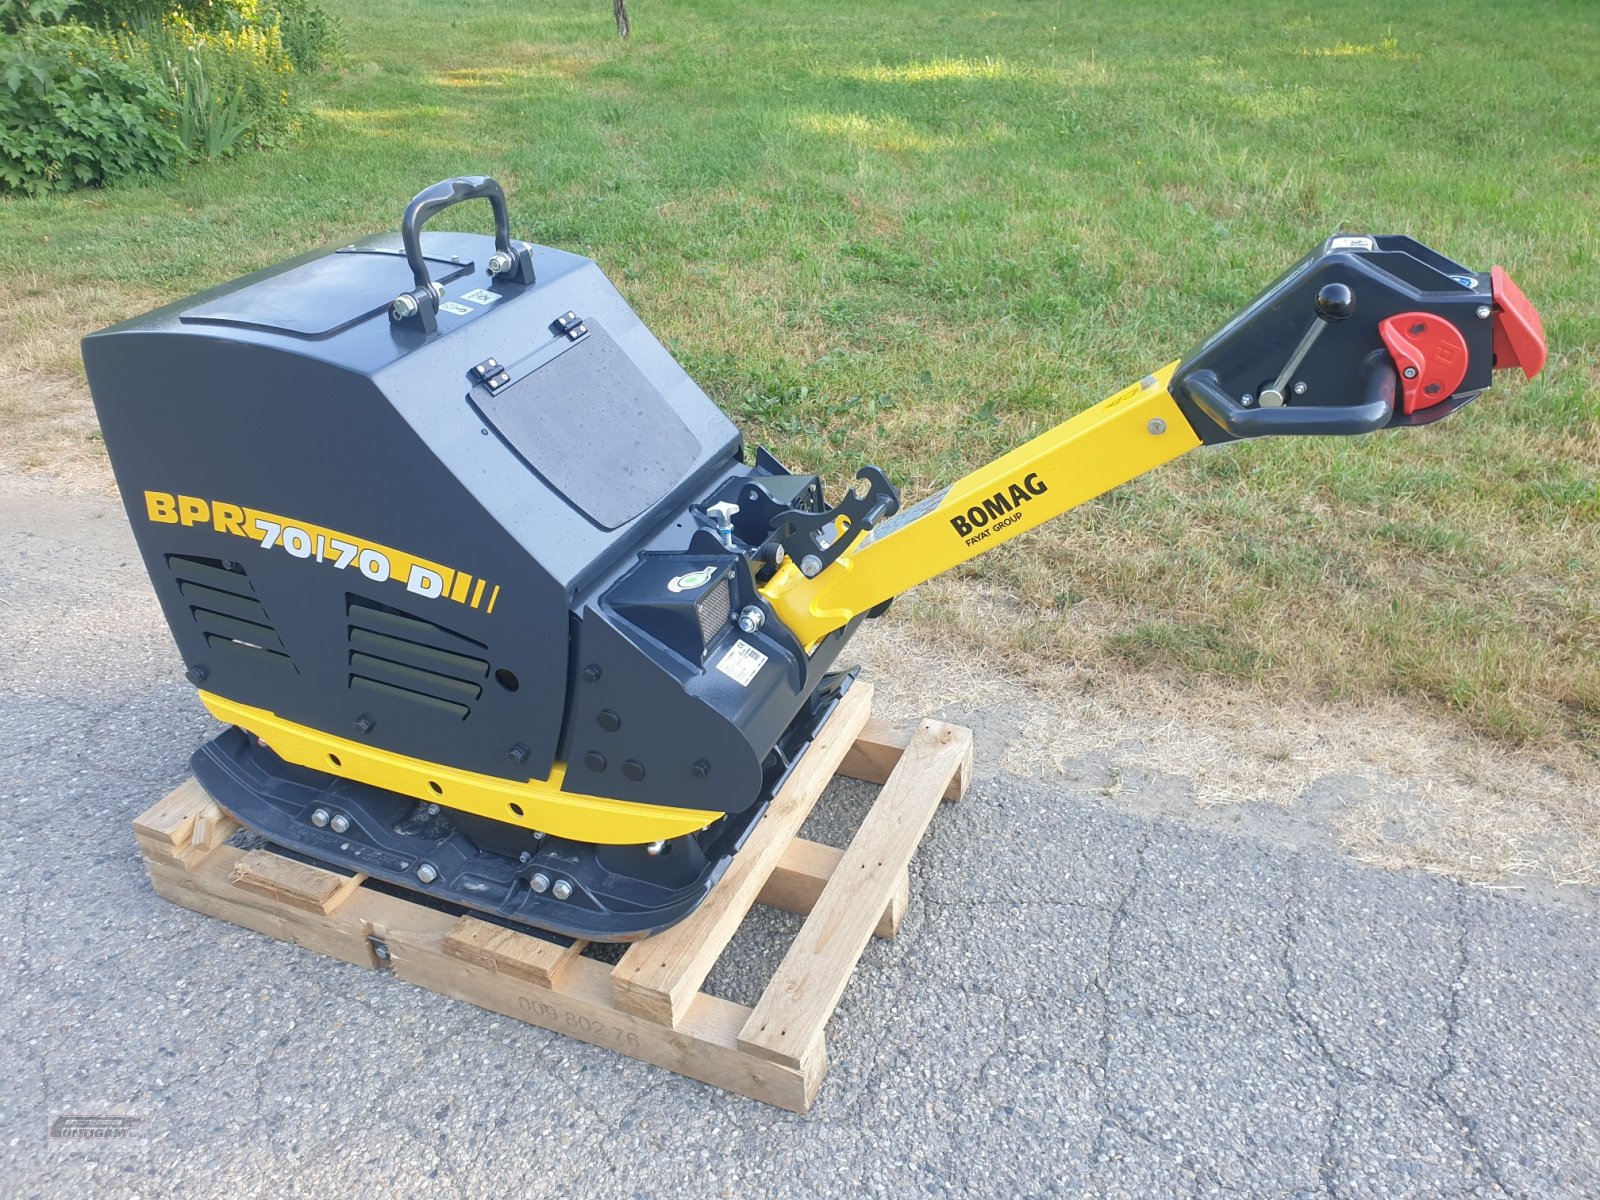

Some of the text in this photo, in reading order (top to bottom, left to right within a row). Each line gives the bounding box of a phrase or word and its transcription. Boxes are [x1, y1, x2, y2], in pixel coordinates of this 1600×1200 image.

[950, 472, 1048, 537] BOMAG
[965, 512, 1022, 547] FAYAT GROUP
[144, 490, 248, 538] BPR
[406, 565, 443, 599] D
